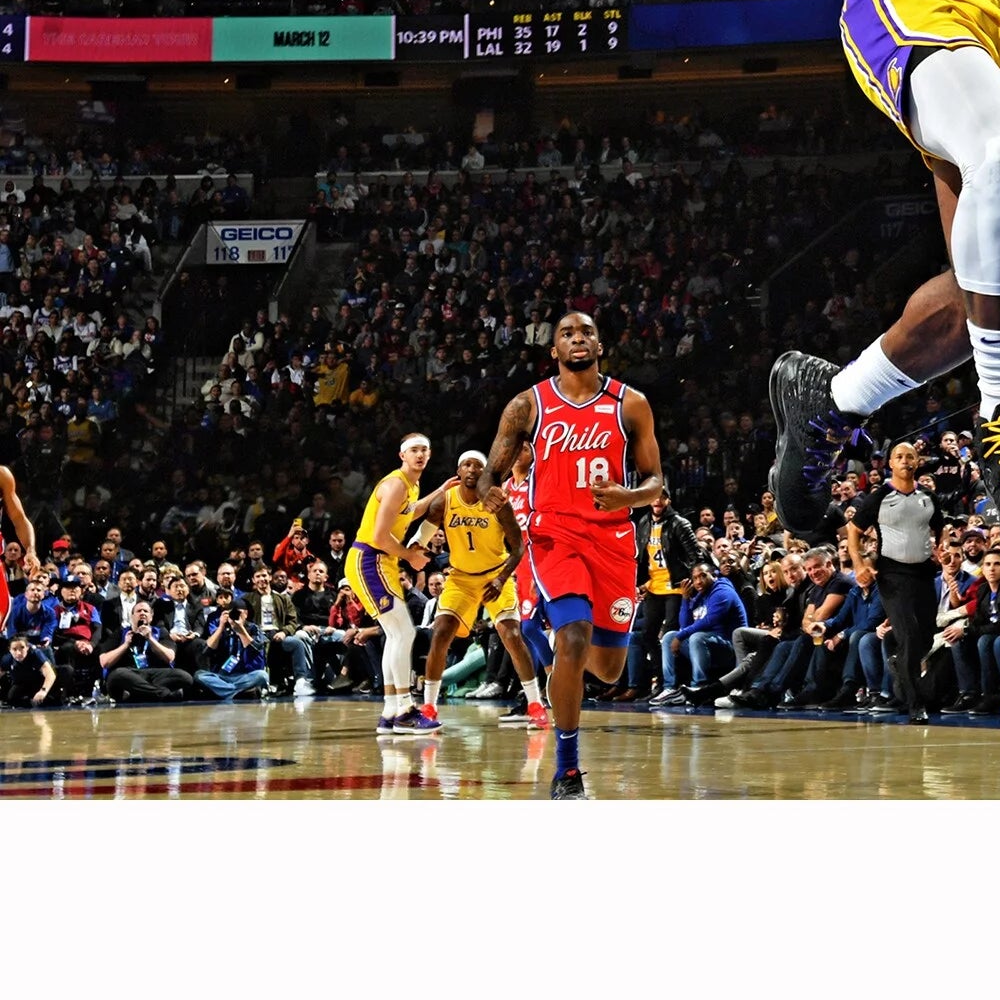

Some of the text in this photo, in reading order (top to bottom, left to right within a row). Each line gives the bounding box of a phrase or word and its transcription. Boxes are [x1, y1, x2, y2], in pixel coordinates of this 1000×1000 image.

[543, 12, 562, 22] AST
[573, 11, 592, 21] BLK
[604, 9, 622, 19] STL
[2, 23, 13, 36] 4
[397, 31, 464, 44] 10:39 PM
[477, 22, 618, 41] PHI 35 17 2 9
[273, 31, 330, 47] MARCH 12
[476, 37, 618, 56] LAL 32 19 1 9
[2, 43, 12, 55] 4
[221, 227, 293, 241] GEICO
[214, 246, 240, 261] 118
[541, 421, 612, 460] Phila
[576, 457, 609, 488] 18
[448, 513, 489, 529] LAKERS
[466, 531, 475, 551] 1
